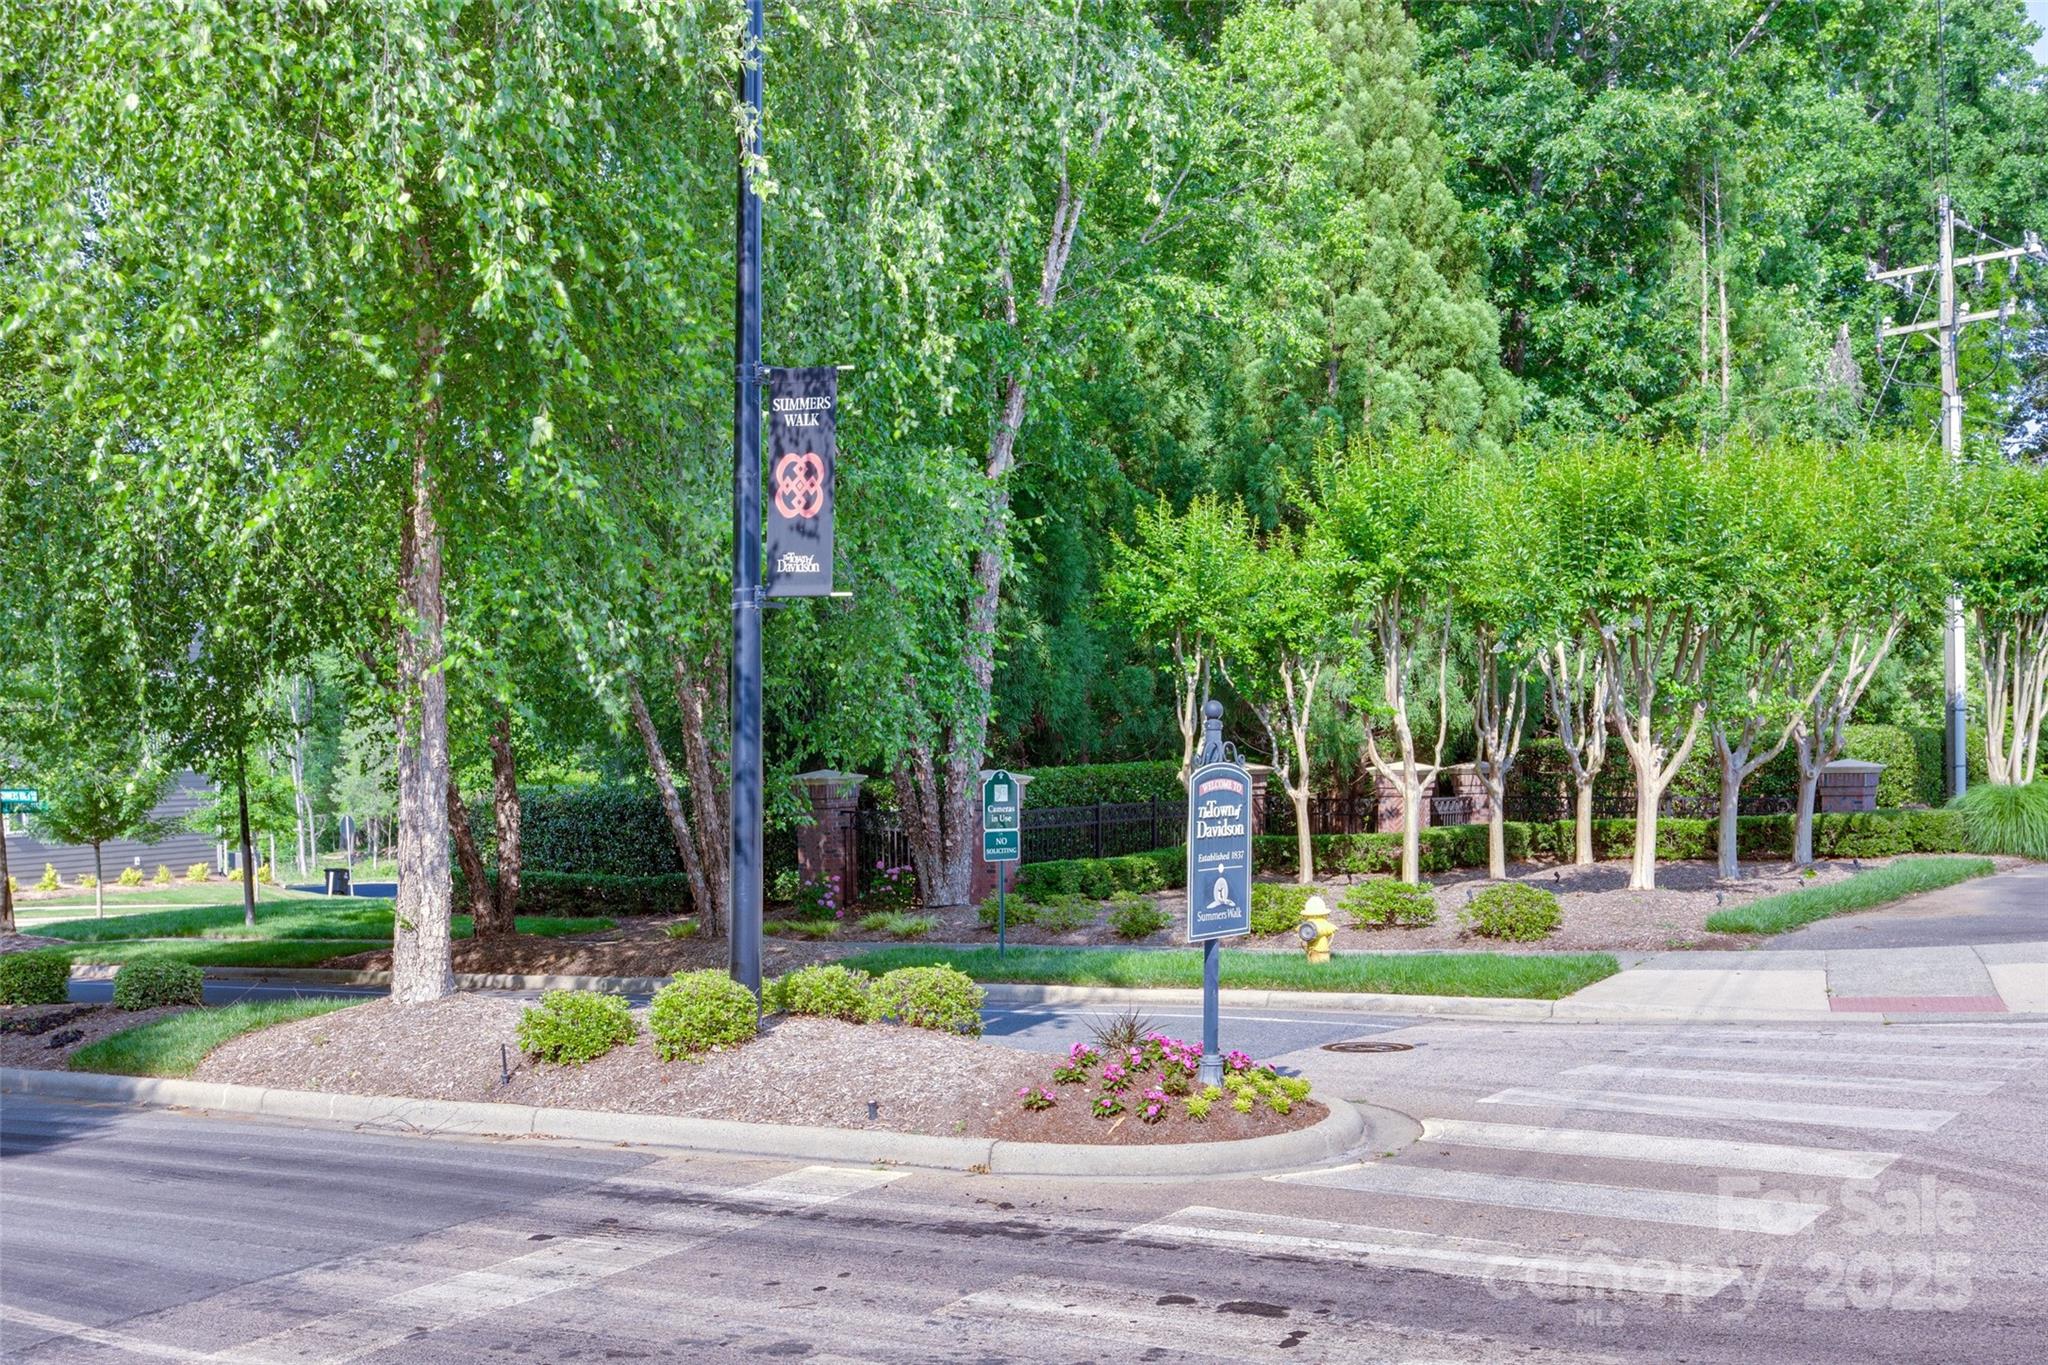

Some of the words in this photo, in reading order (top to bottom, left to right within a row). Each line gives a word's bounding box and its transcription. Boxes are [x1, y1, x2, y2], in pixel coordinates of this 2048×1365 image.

[773, 397, 831, 412] SUMMERS
[784, 413, 819, 427] WALK
[777, 559, 820, 572] Davidson
[1203, 779, 1232, 793] WELCOME
[1232, 782, 1242, 793] TO
[988, 805, 1015, 813] Cameras
[1206, 800, 1235, 818] Town
[991, 814, 998, 822] in
[999, 814, 1012, 822] Use
[1197, 819, 1245, 839] Davidson
[995, 837, 1008, 846] NO
[986, 847, 1017, 855] SOLICITING
[1198, 852, 1230, 863] Established
[1197, 910, 1228, 922] Summers
[1227, 907, 1242, 918] Walk
